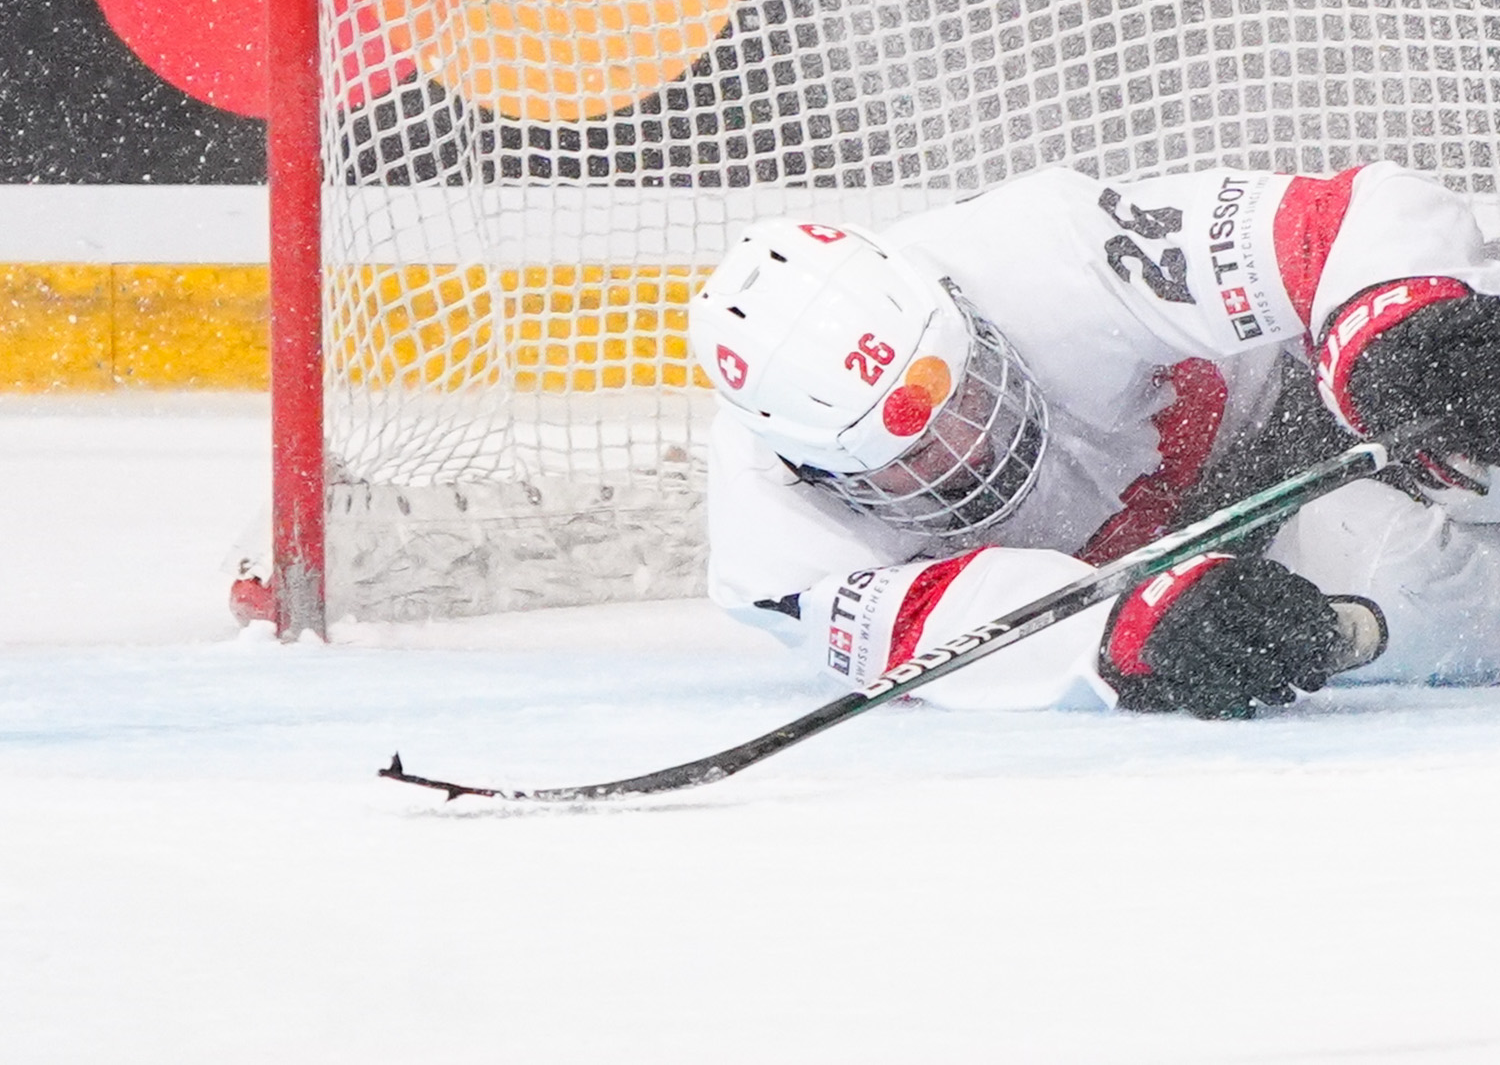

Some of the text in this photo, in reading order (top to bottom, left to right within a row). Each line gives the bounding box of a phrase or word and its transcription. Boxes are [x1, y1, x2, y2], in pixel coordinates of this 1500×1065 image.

[1210, 177, 1248, 285] TISSOT
[1241, 216, 1260, 284] WATCHES
[845, 332, 895, 386] 26
[831, 568, 879, 622] TIS
[862, 577, 890, 642] WATCHES
